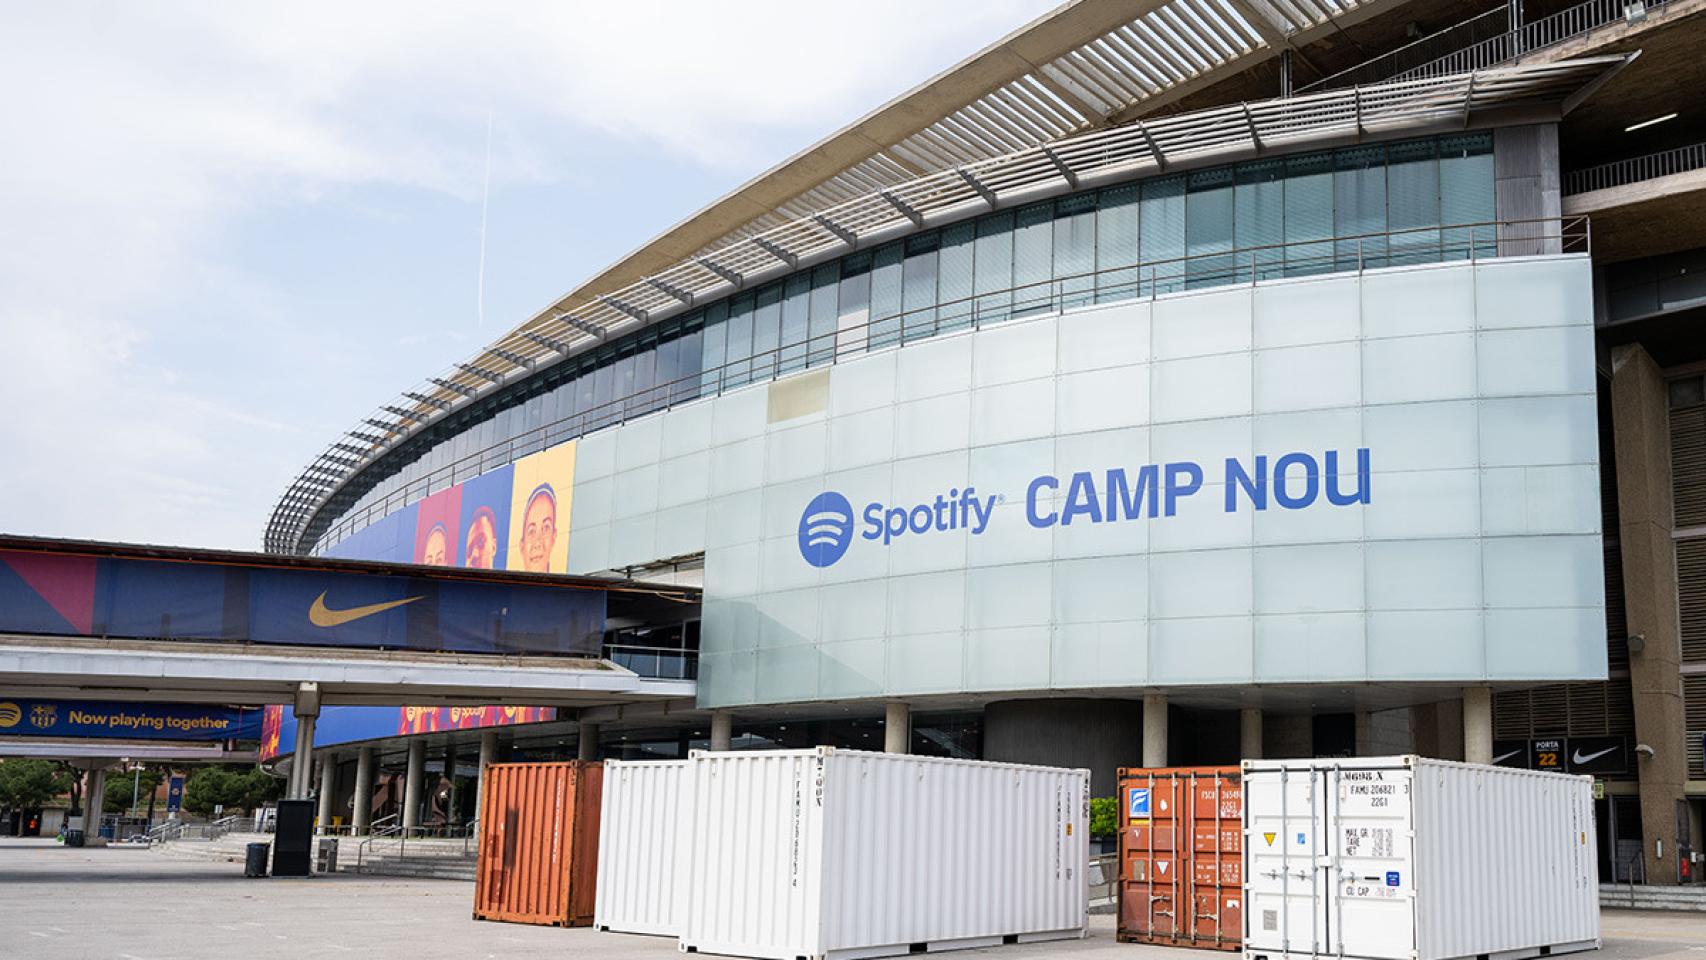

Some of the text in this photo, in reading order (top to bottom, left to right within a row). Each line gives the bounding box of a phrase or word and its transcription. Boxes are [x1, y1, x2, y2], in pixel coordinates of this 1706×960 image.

[1026, 461, 1204, 529] CAMP
[1225, 447, 1371, 513] NOU
[69, 710, 229, 730] Now playing together
[1536, 741, 1559, 749] PORTA
[1539, 753, 1557, 766] 22
[1350, 784, 1370, 795] FAMU
[1371, 784, 1396, 795] 206821
[1371, 797, 1388, 807] 22G1
[1357, 886, 1370, 897] CAP
